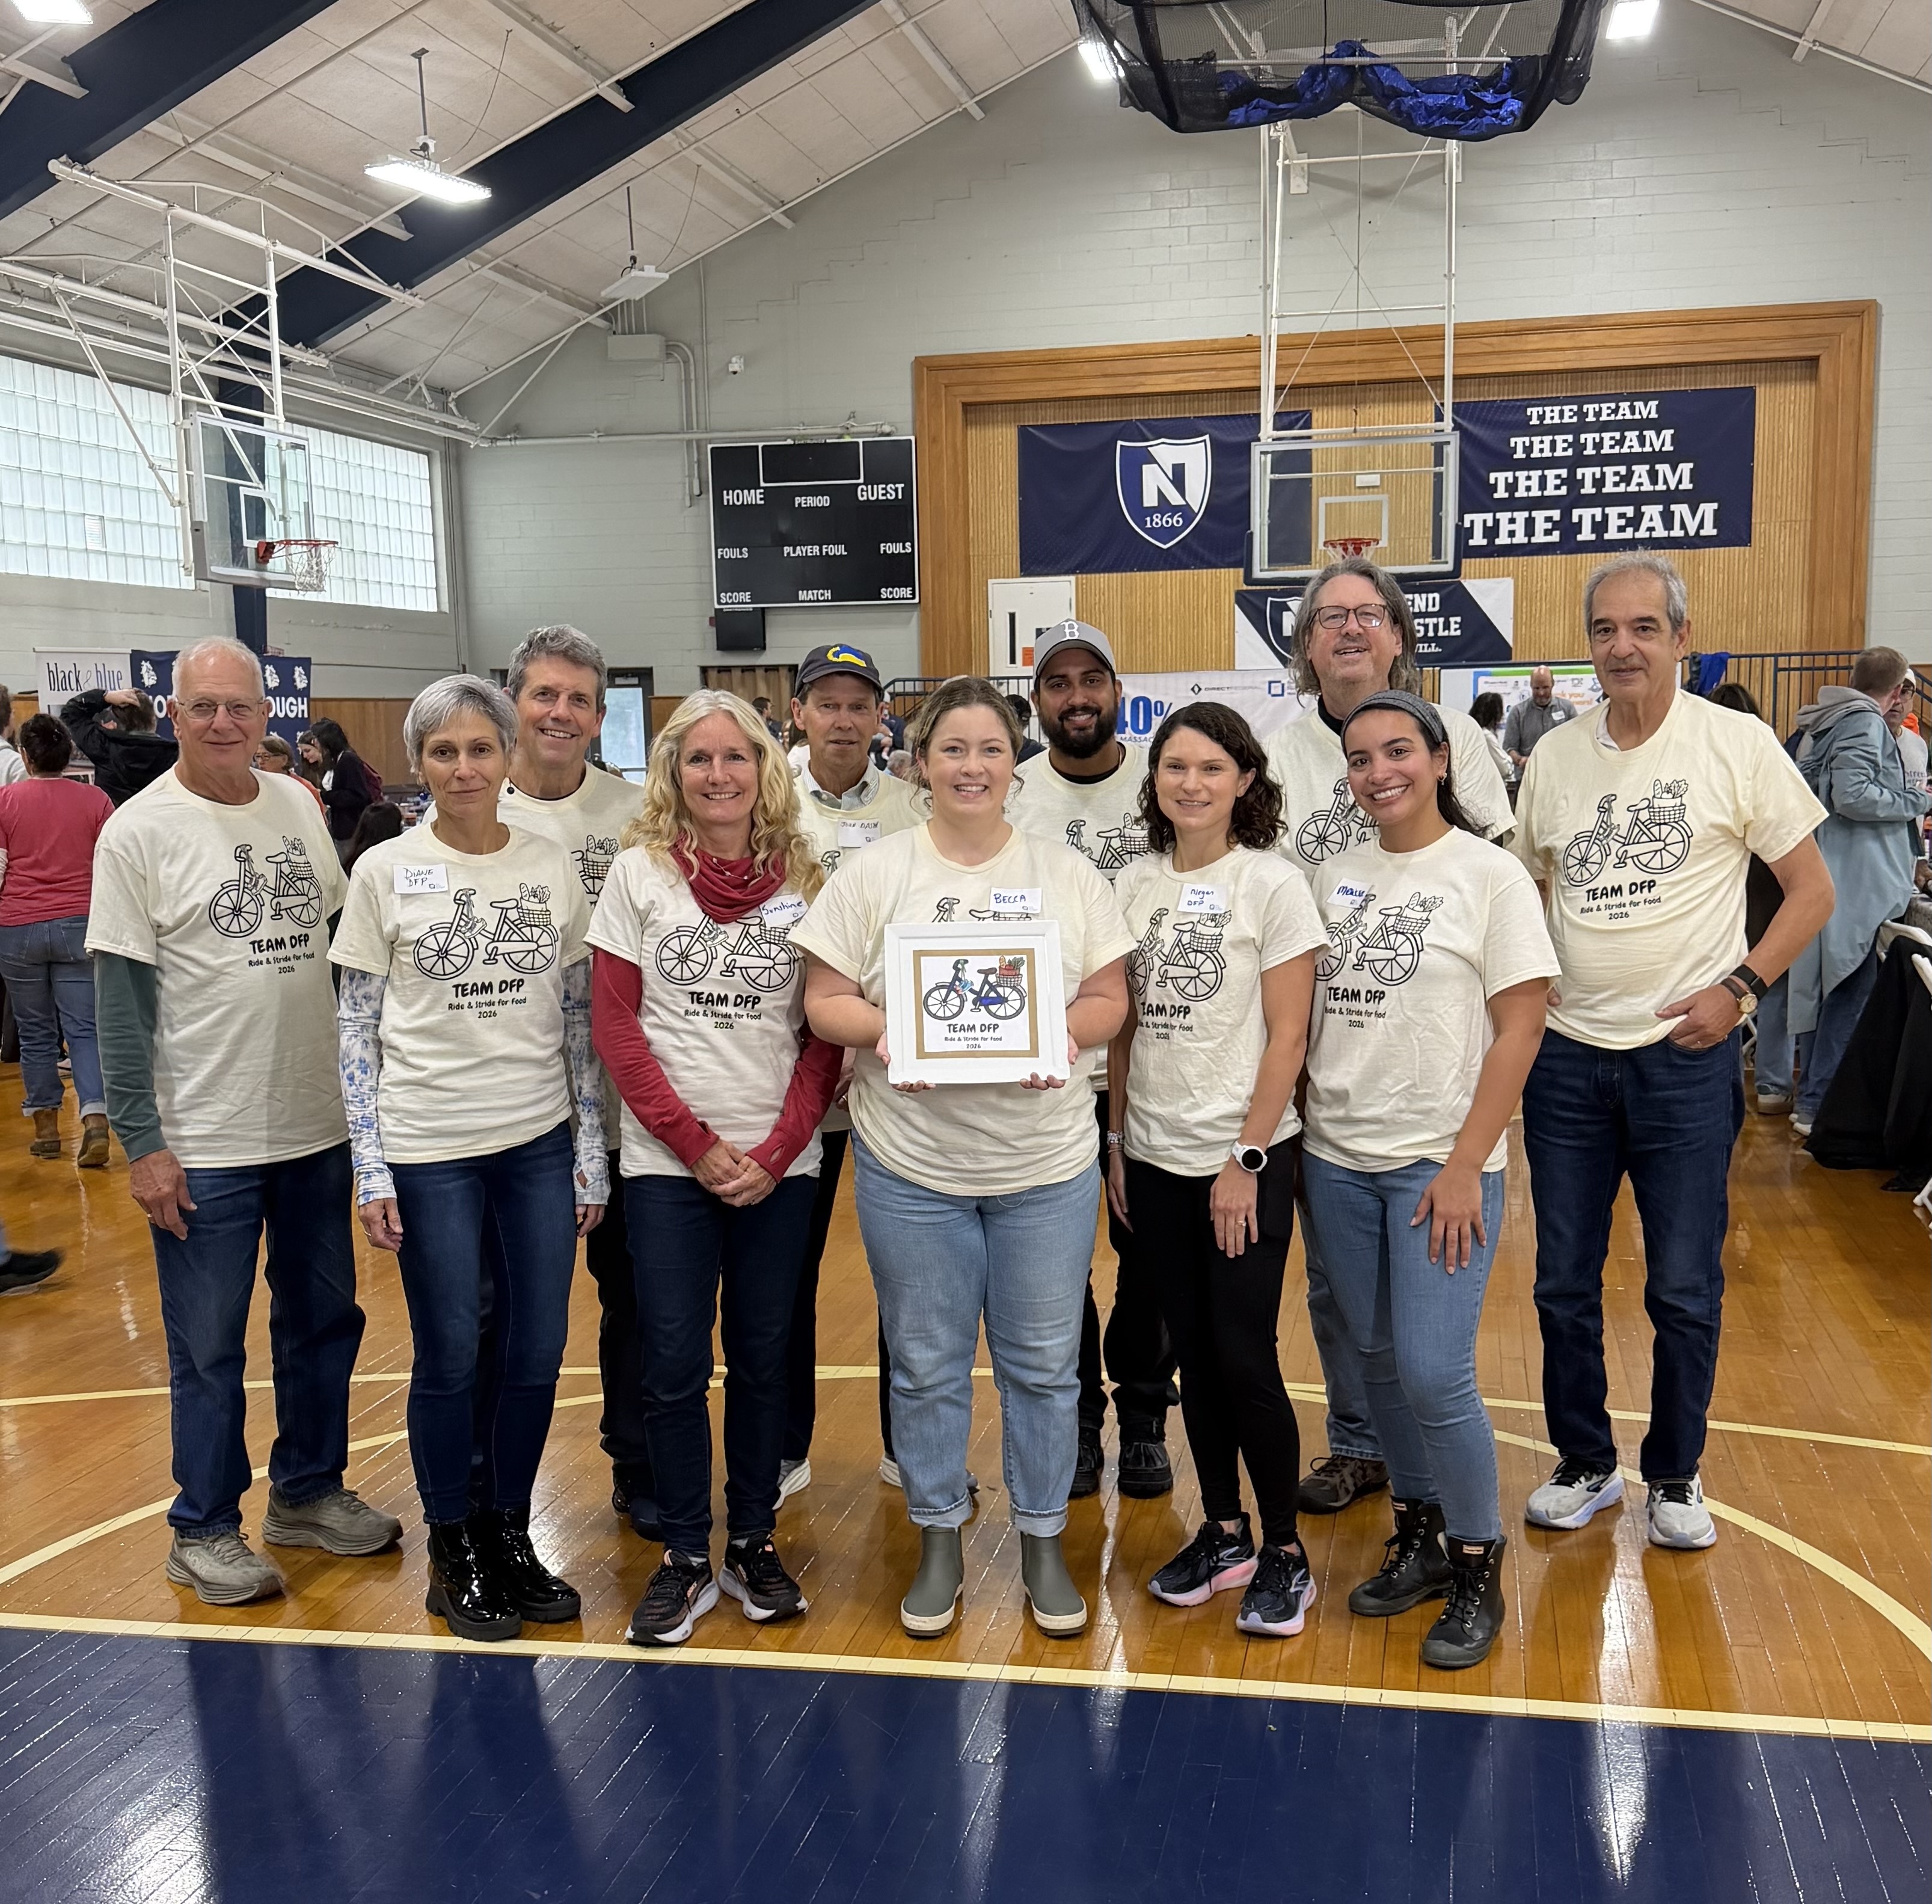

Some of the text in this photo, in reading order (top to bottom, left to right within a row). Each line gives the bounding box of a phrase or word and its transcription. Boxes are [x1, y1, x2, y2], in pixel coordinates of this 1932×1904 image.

[1527, 399, 1660, 426] THE TEAM
[1510, 428, 1674, 459] THE TEAM
[1142, 457, 1197, 510] N
[1489, 462, 1694, 499] THE TEAM
[723, 489, 765, 506] HOME
[857, 484, 904, 501] GUEST
[794, 496, 830, 508] PERIOD
[1144, 512, 1183, 528] 1866
[1463, 502, 1719, 547] THE TEAM
[717, 548, 749, 559] FOULS
[784, 544, 848, 557] PLAYER FOUL
[880, 542, 912, 554] FOULS
[720, 592, 752, 603] SCORE
[799, 589, 832, 601] MATCH
[880, 587, 913, 599] SCORE
[1060, 621, 1080, 640] B
[46, 662, 83, 692] black
[94, 663, 123, 691] blue
[408, 877, 428, 887] DFP
[1586, 879, 1657, 902] TEAM DFP
[993, 893, 1026, 903] BECCA
[1643, 896, 1661, 905] Food
[1608, 911, 1630, 920] 2026
[249, 933, 310, 954] TEAM DFP
[248, 959, 263, 967] Ride
[273, 955, 291, 964] Stride
[303, 951, 315, 960] Food
[278, 965, 295, 974] 2026
[452, 978, 525, 998] TEAM DFP
[688, 991, 761, 1010] TEAM DFP
[1327, 986, 1385, 1005] TEAM DFP
[448, 1003, 465, 1011] Ride
[475, 1000, 495, 1009] Stride
[511, 997, 527, 1005] Food
[477, 1010, 497, 1019] 2026
[684, 1009, 700, 1018] Ride
[710, 1010, 732, 1019] Stride
[1170, 1004, 1191, 1020] DFP
[1346, 1007, 1363, 1016] Stride
[1364, 1009, 1373, 1018] for
[714, 1021, 734, 1030] 2026
[946, 1023, 999, 1033] TEAM DFP
[1179, 1024, 1194, 1032] Food
[1349, 1019, 1364, 1028] 2026
